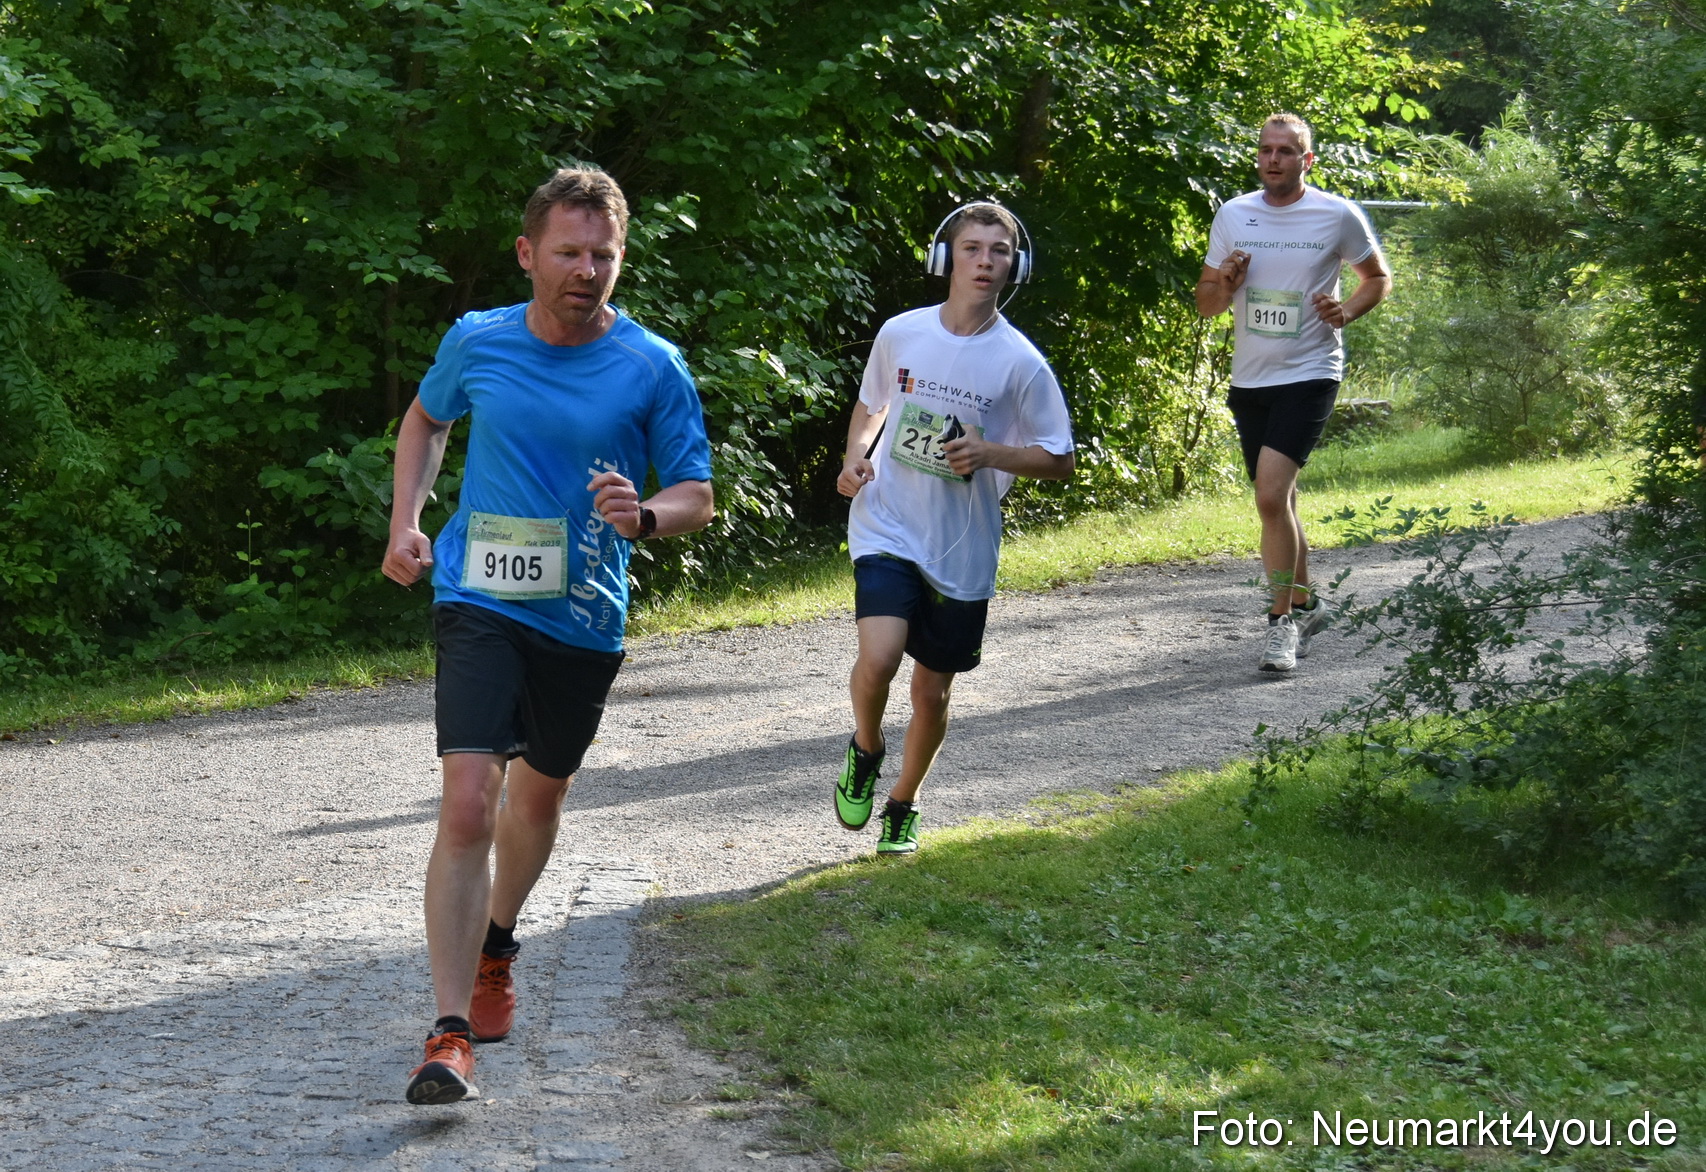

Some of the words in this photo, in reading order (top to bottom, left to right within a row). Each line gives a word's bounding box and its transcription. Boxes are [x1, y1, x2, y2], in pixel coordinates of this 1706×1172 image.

[1234, 241, 1280, 249] RUPPRECHT
[1284, 242, 1325, 250] HOLZBAU
[1254, 309, 1287, 326] 9110
[915, 391, 955, 404] COMPUTER
[917, 379, 993, 407] SCHWARZ
[902, 427, 947, 461] 213
[932, 459, 951, 470] Jama
[485, 551, 543, 581] 9105
